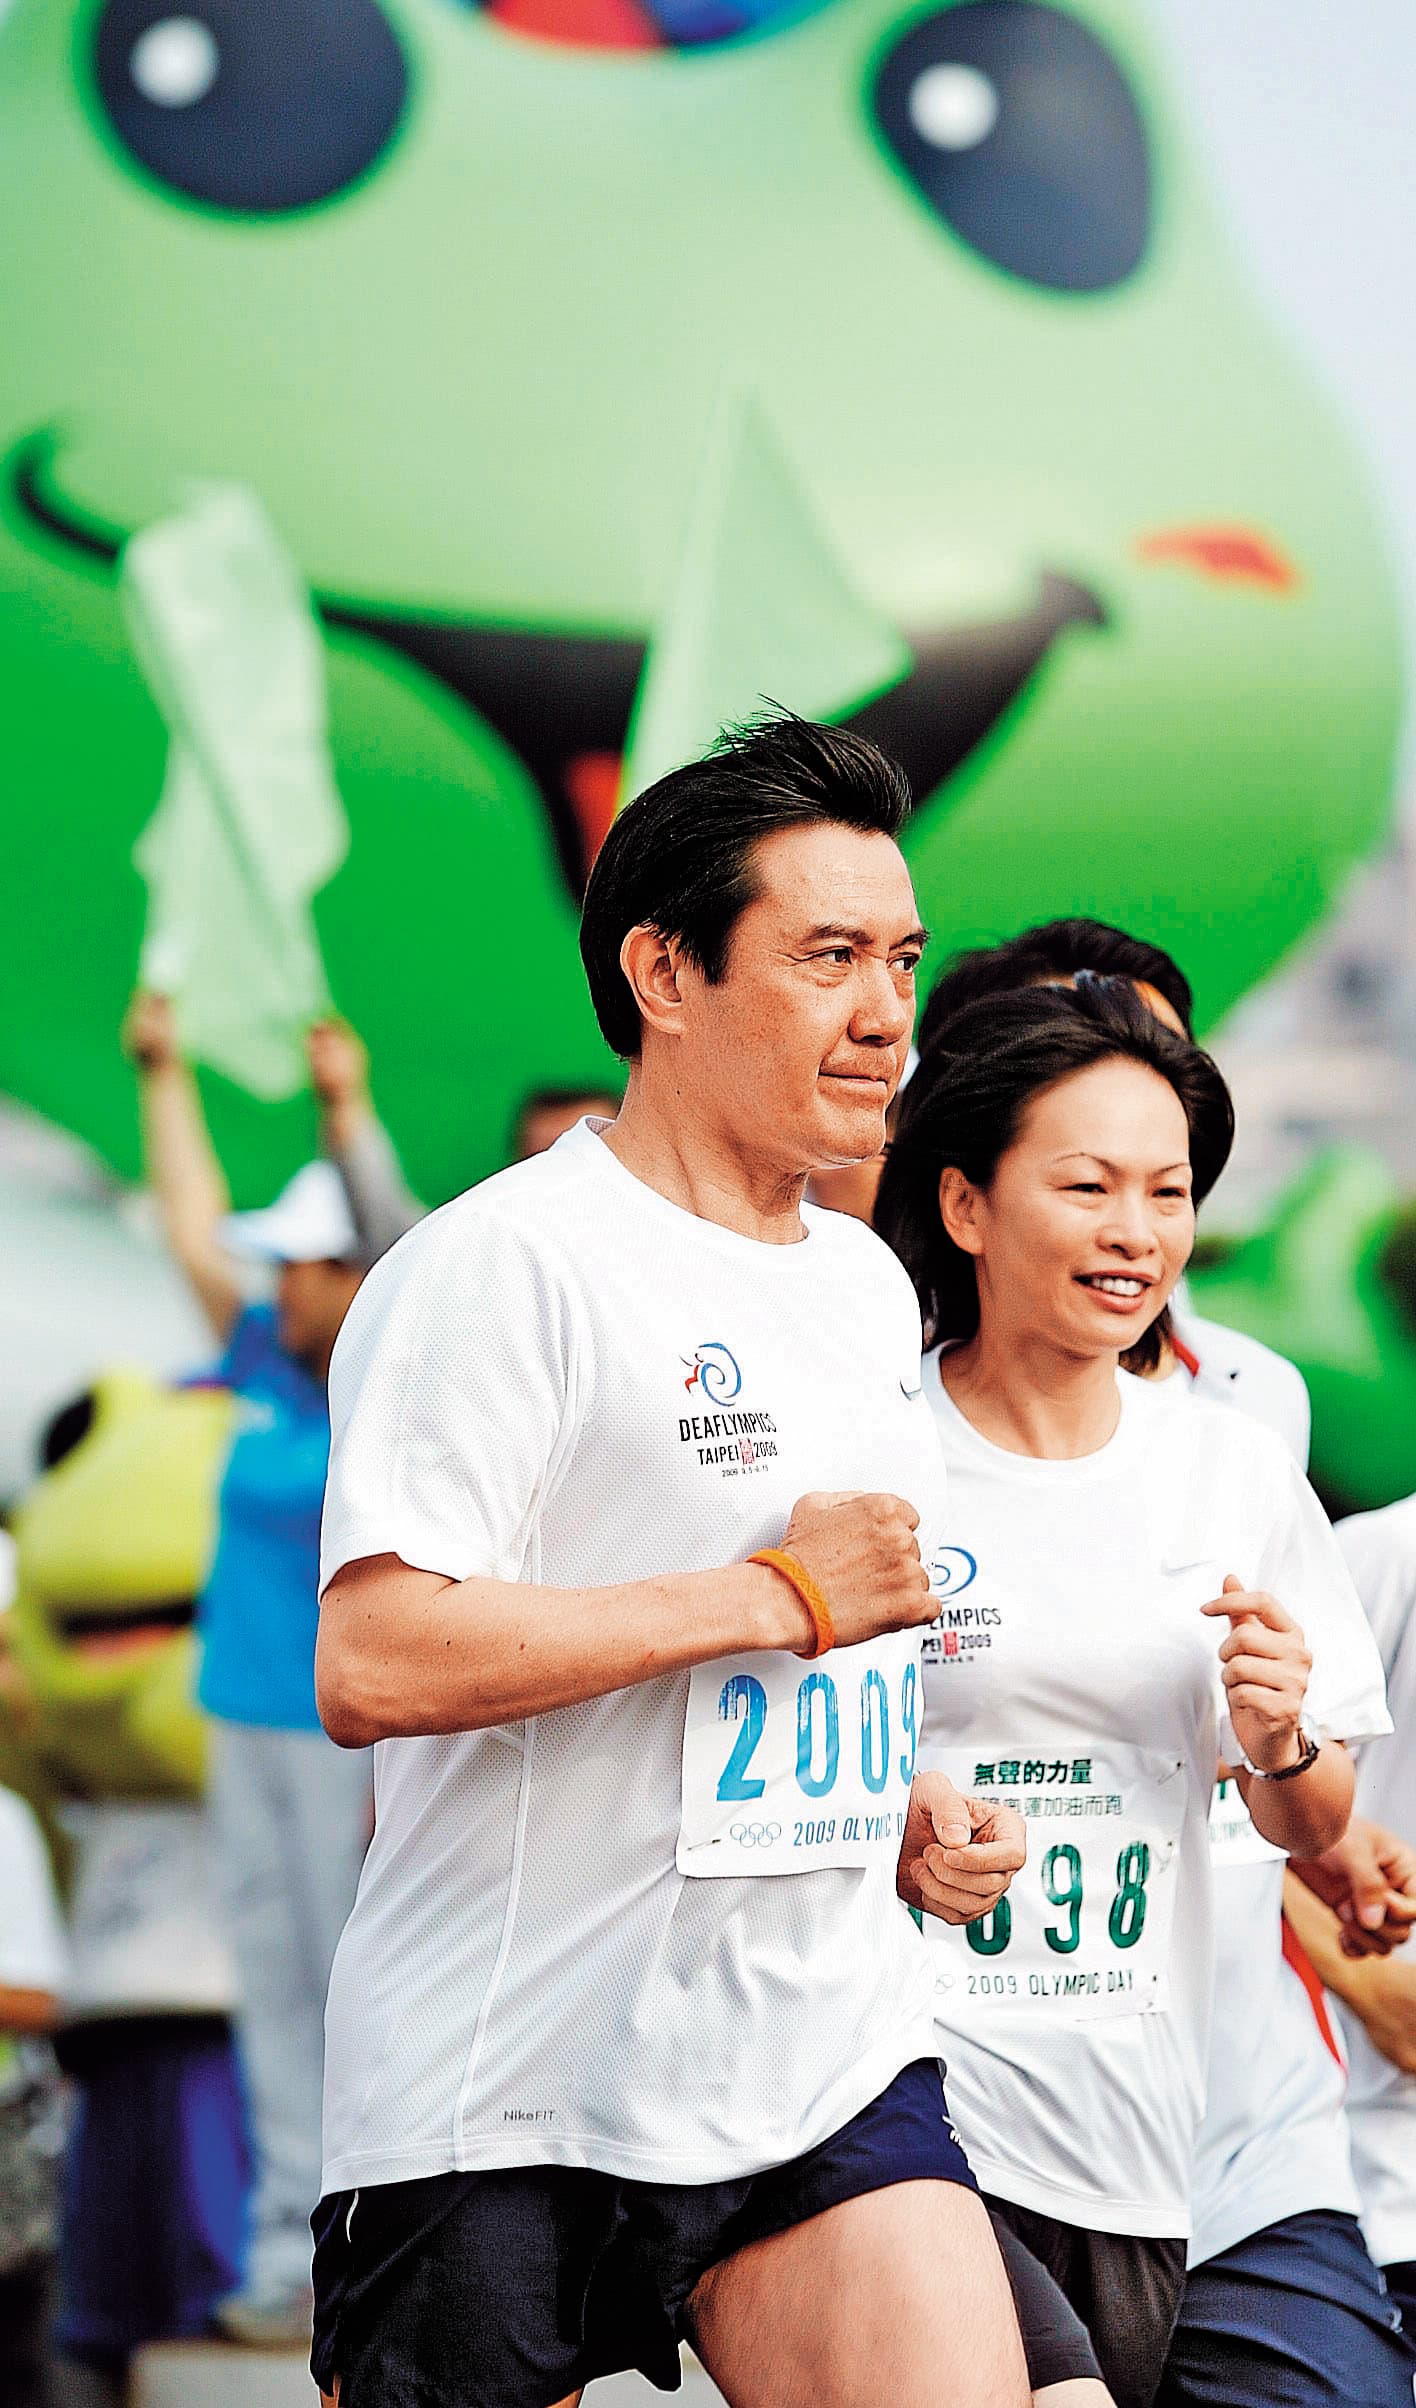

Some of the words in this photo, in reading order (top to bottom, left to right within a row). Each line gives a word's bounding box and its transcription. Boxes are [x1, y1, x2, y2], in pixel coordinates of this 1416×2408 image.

[679, 1412, 777, 1442] DEAFLYMPICS
[697, 1444, 739, 1465] TAIPEI
[960, 1633, 992, 1650] 2009
[716, 1662, 917, 1802] 2009
[973, 1758, 1092, 1786] 無聲的力量
[793, 1819, 836, 1847] 2009
[967, 1975, 1017, 1994] 2009
[1029, 1972, 1101, 1996] OLYMPIC
[1107, 1968, 1134, 1992] DAY
